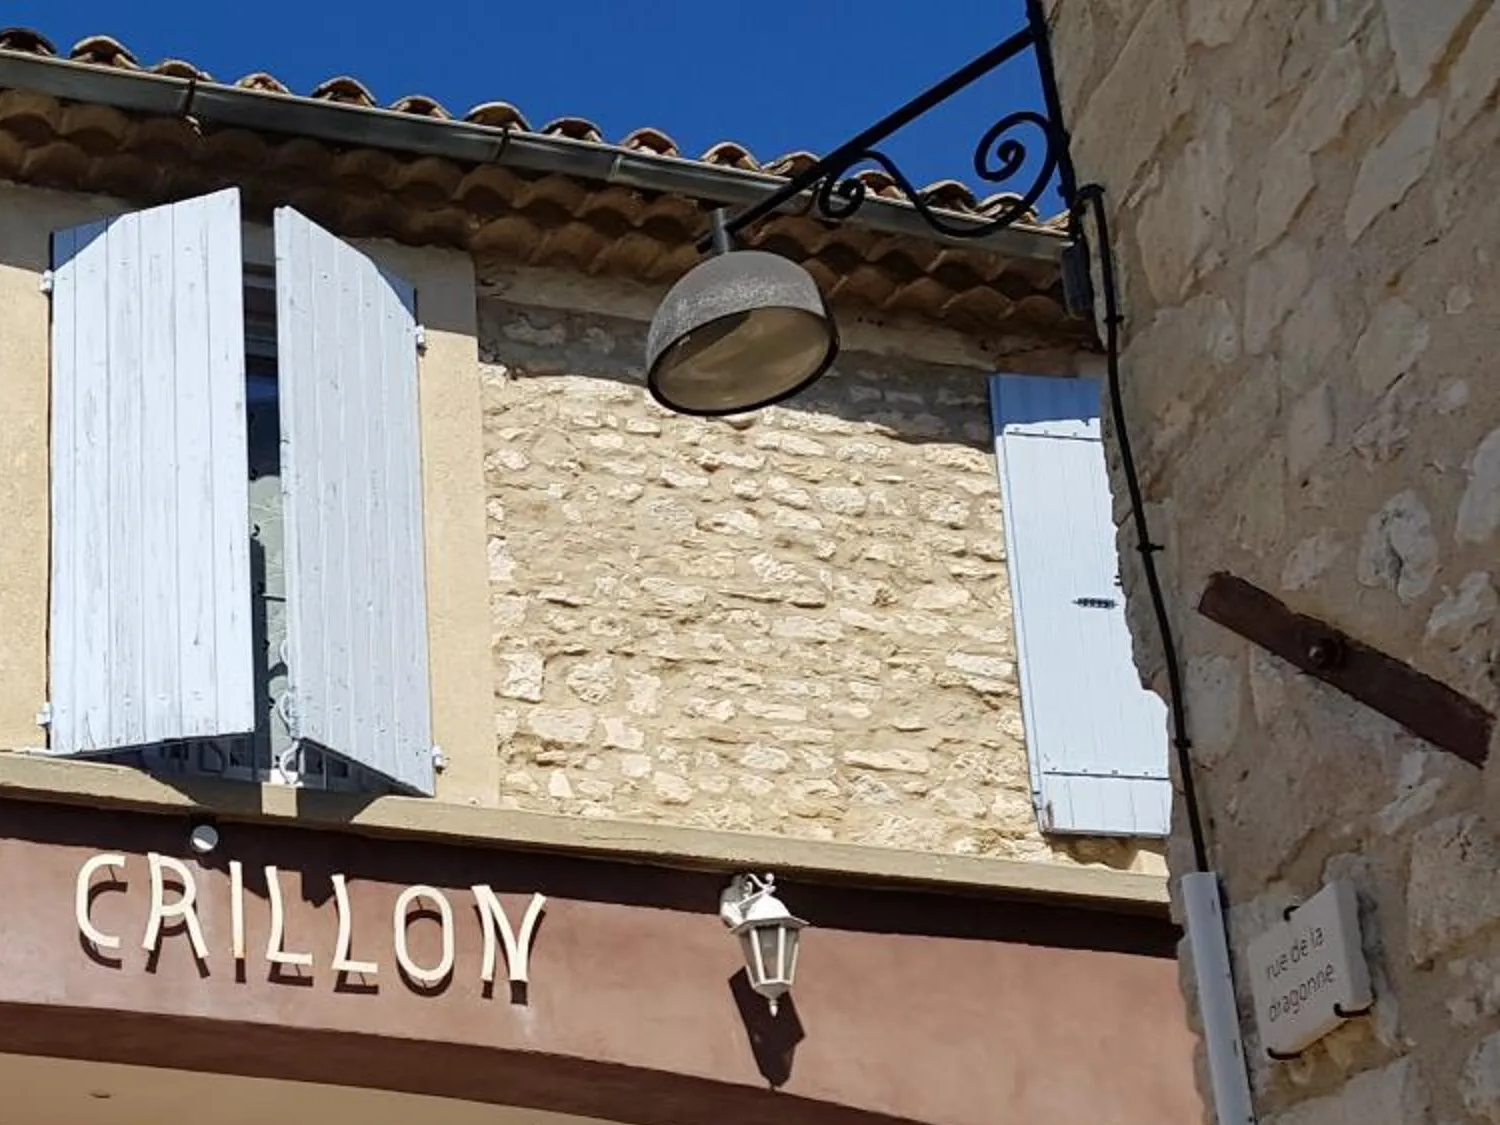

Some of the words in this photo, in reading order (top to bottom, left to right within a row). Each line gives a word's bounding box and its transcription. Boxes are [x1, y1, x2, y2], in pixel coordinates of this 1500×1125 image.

[75, 851, 547, 983] CRILLON
[1267, 954, 1288, 979] rue
[1291, 938, 1308, 963] de
[1310, 927, 1324, 948] la
